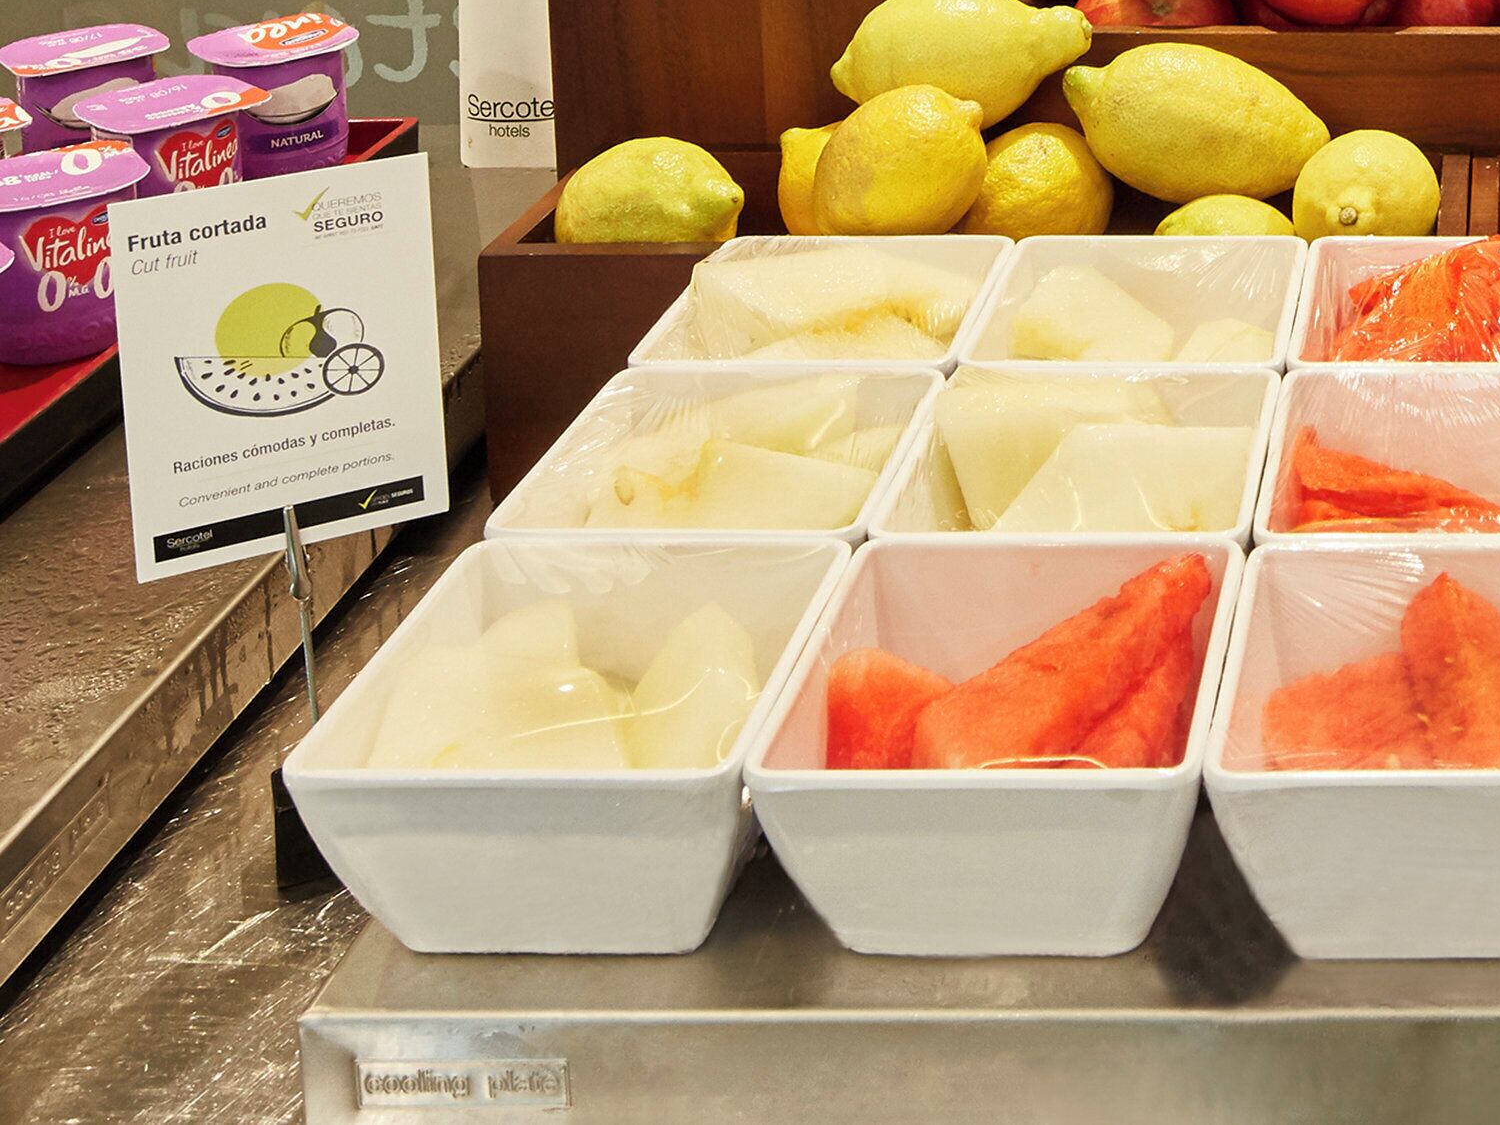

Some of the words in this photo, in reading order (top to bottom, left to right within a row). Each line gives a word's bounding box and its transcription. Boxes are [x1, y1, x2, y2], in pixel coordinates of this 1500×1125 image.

[467, 93, 555, 120] Sercote
[271, 130, 324, 149] NATURAL
[489, 123, 530, 138] hotels
[154, 139, 238, 182] Vitalinea
[311, 192, 382, 212] QUEREMOS
[57, 225, 76, 238] love
[127, 229, 182, 252] Fruta
[189, 215, 267, 241] cortada
[313, 211, 384, 232] SEGURO
[18, 226, 112, 272] Vitalin
[131, 257, 160, 276] Cut
[164, 250, 198, 269] fruit
[173, 452, 239, 474] Raciones
[242, 436, 306, 459] cómodas
[309, 434, 319, 447] y
[321, 418, 396, 442] completas.
[179, 483, 251, 508] Convenient
[254, 477, 278, 491] and
[281, 464, 339, 485] complete
[341, 451, 395, 474] portions.
[166, 528, 213, 549] Sercotel
[364, 1069, 470, 1098] cooling
[486, 1070, 560, 1098] plate
